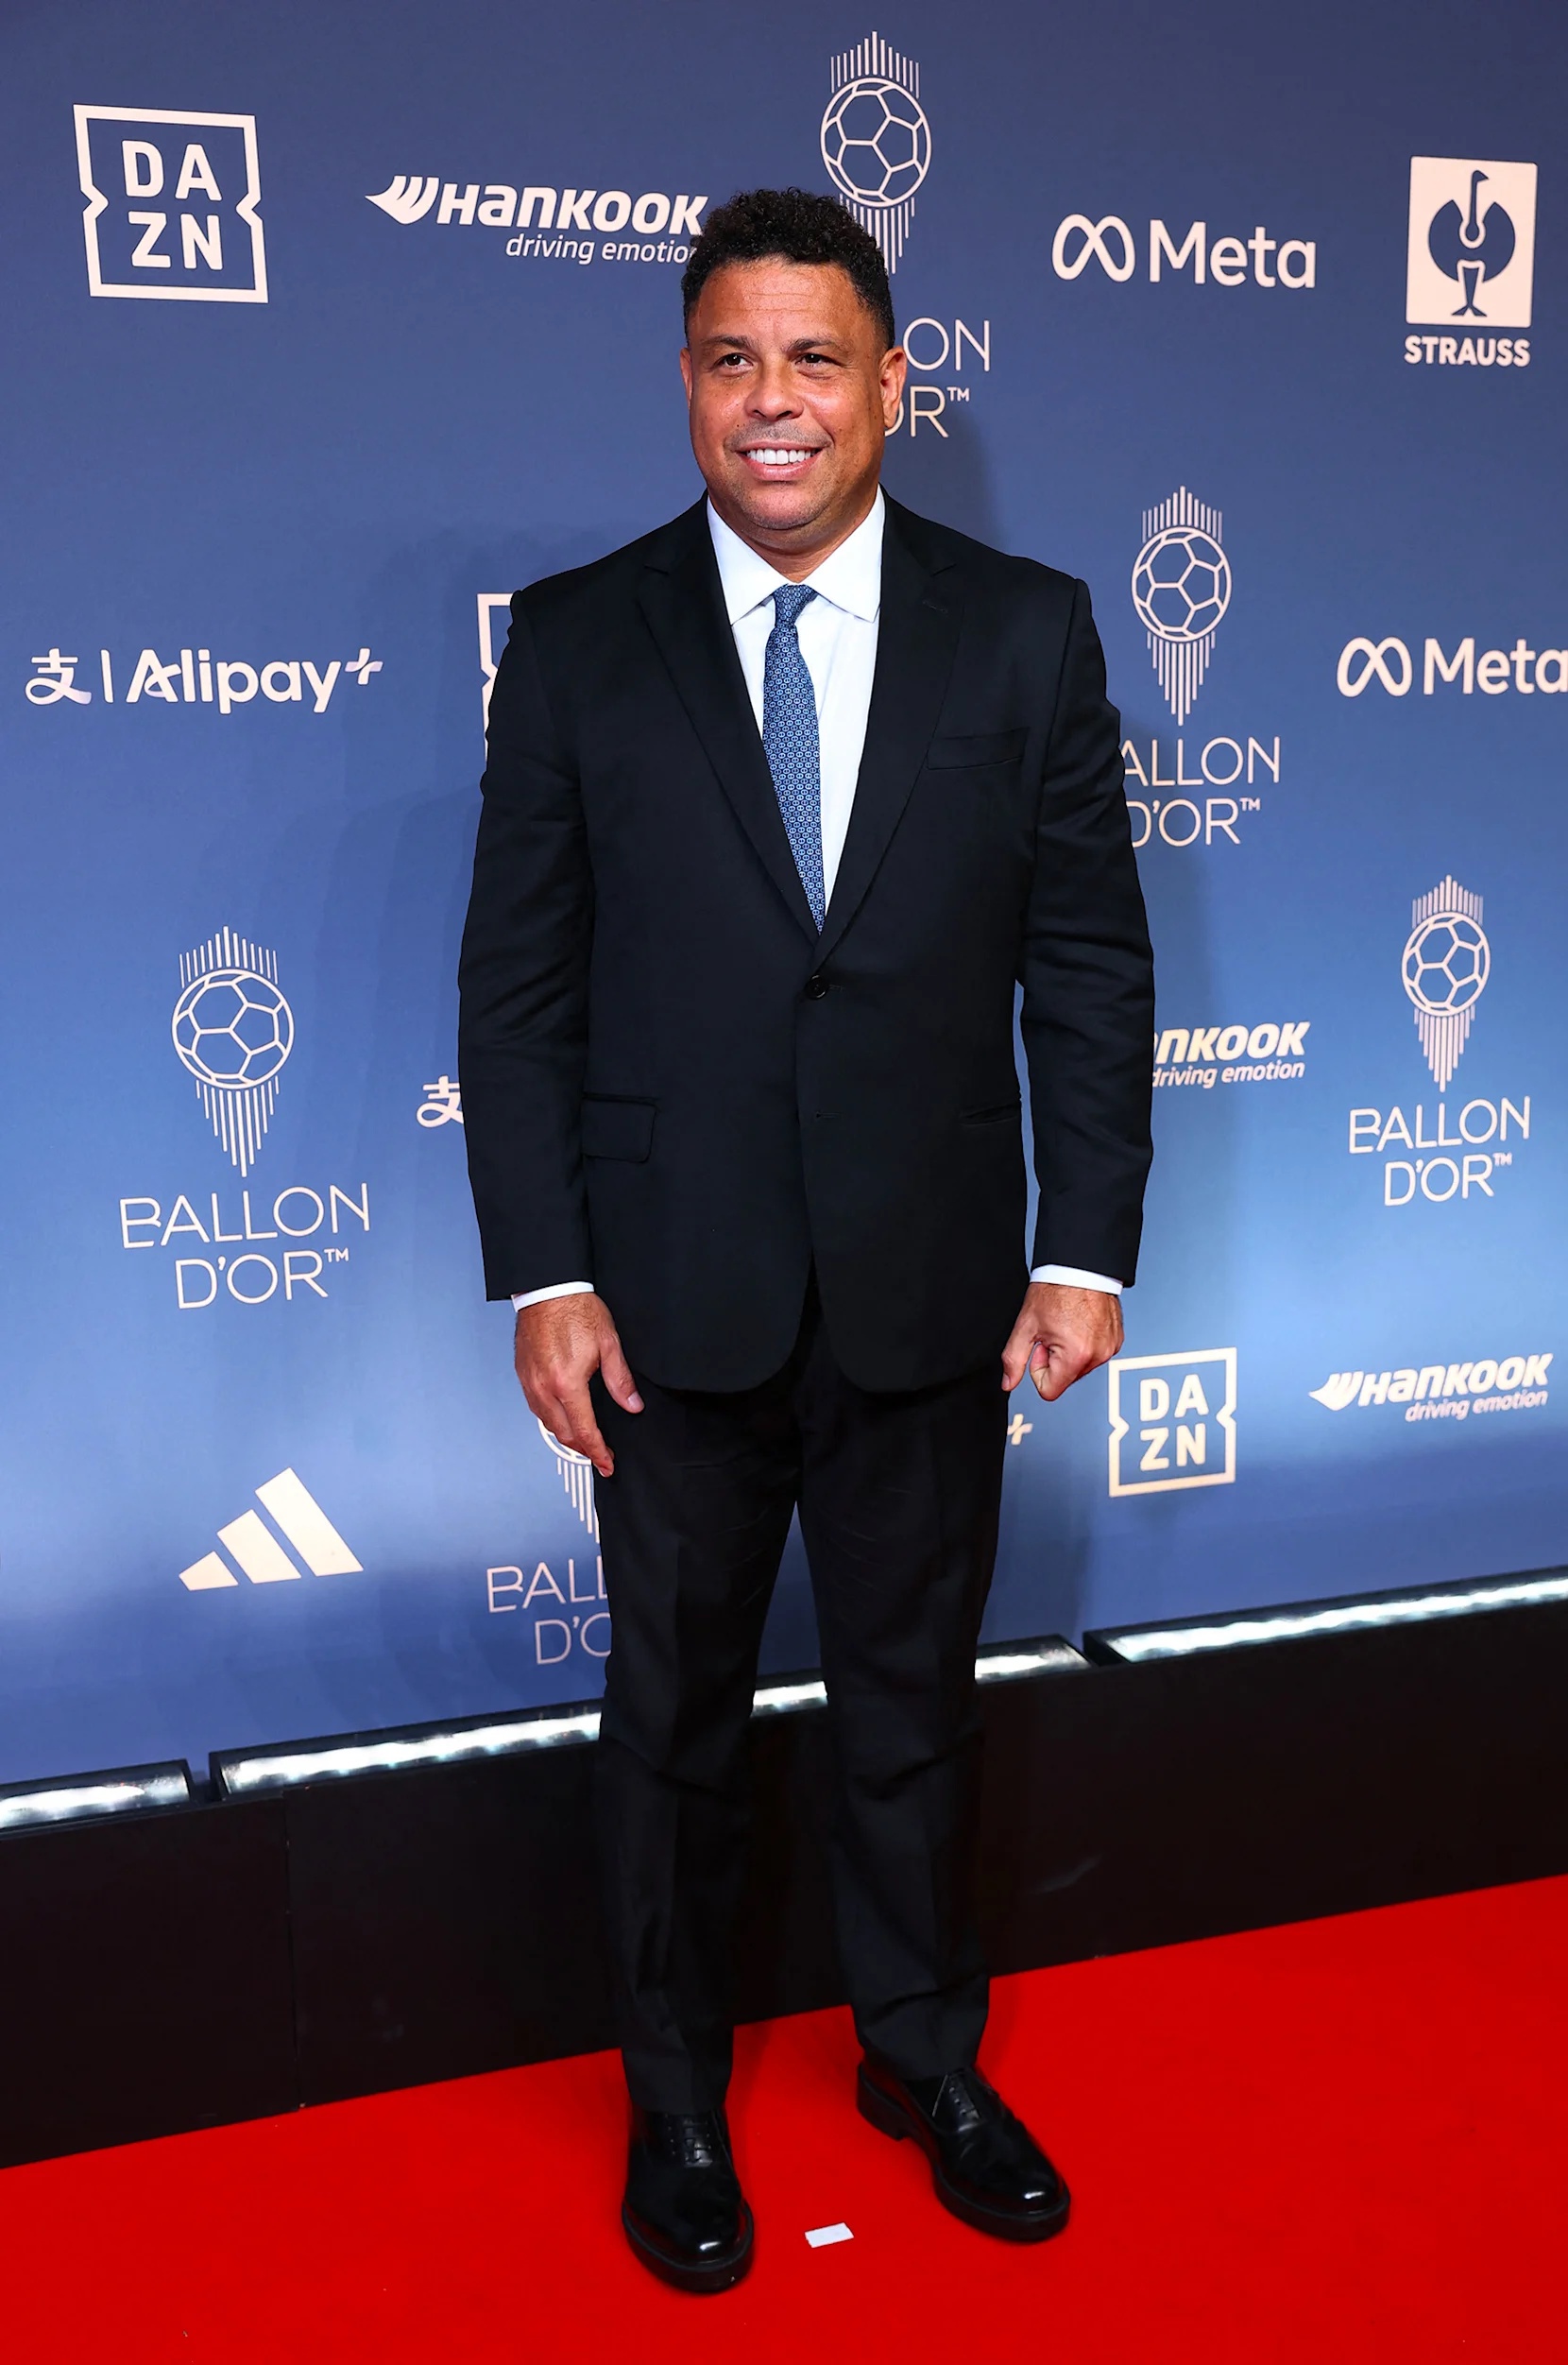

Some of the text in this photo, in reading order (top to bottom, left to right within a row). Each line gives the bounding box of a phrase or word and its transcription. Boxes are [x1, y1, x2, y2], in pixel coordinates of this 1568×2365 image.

[122, 140, 222, 201] DA
[128, 211, 223, 270] ZN
[505, 233, 595, 266] driving
[1149, 219, 1317, 289] Meta
[1403, 334, 1531, 368] STRAUSS
[1423, 637, 1568, 695] Meta
[1120, 736, 1281, 787] ALLON
[1153, 1020, 1311, 1065] nKOOK
[1152, 1058, 1305, 1089] driving emotion
[1348, 1095, 1531, 1154] BALLON
[119, 1182, 370, 1248] BALLON
[1139, 1373, 1210, 1422] DA
[1405, 1389, 1549, 1422] driving emotion
[1139, 1422, 1207, 1472] ZN
[486, 1554, 608, 1613] BALL
[534, 1611, 612, 1665] D'O
